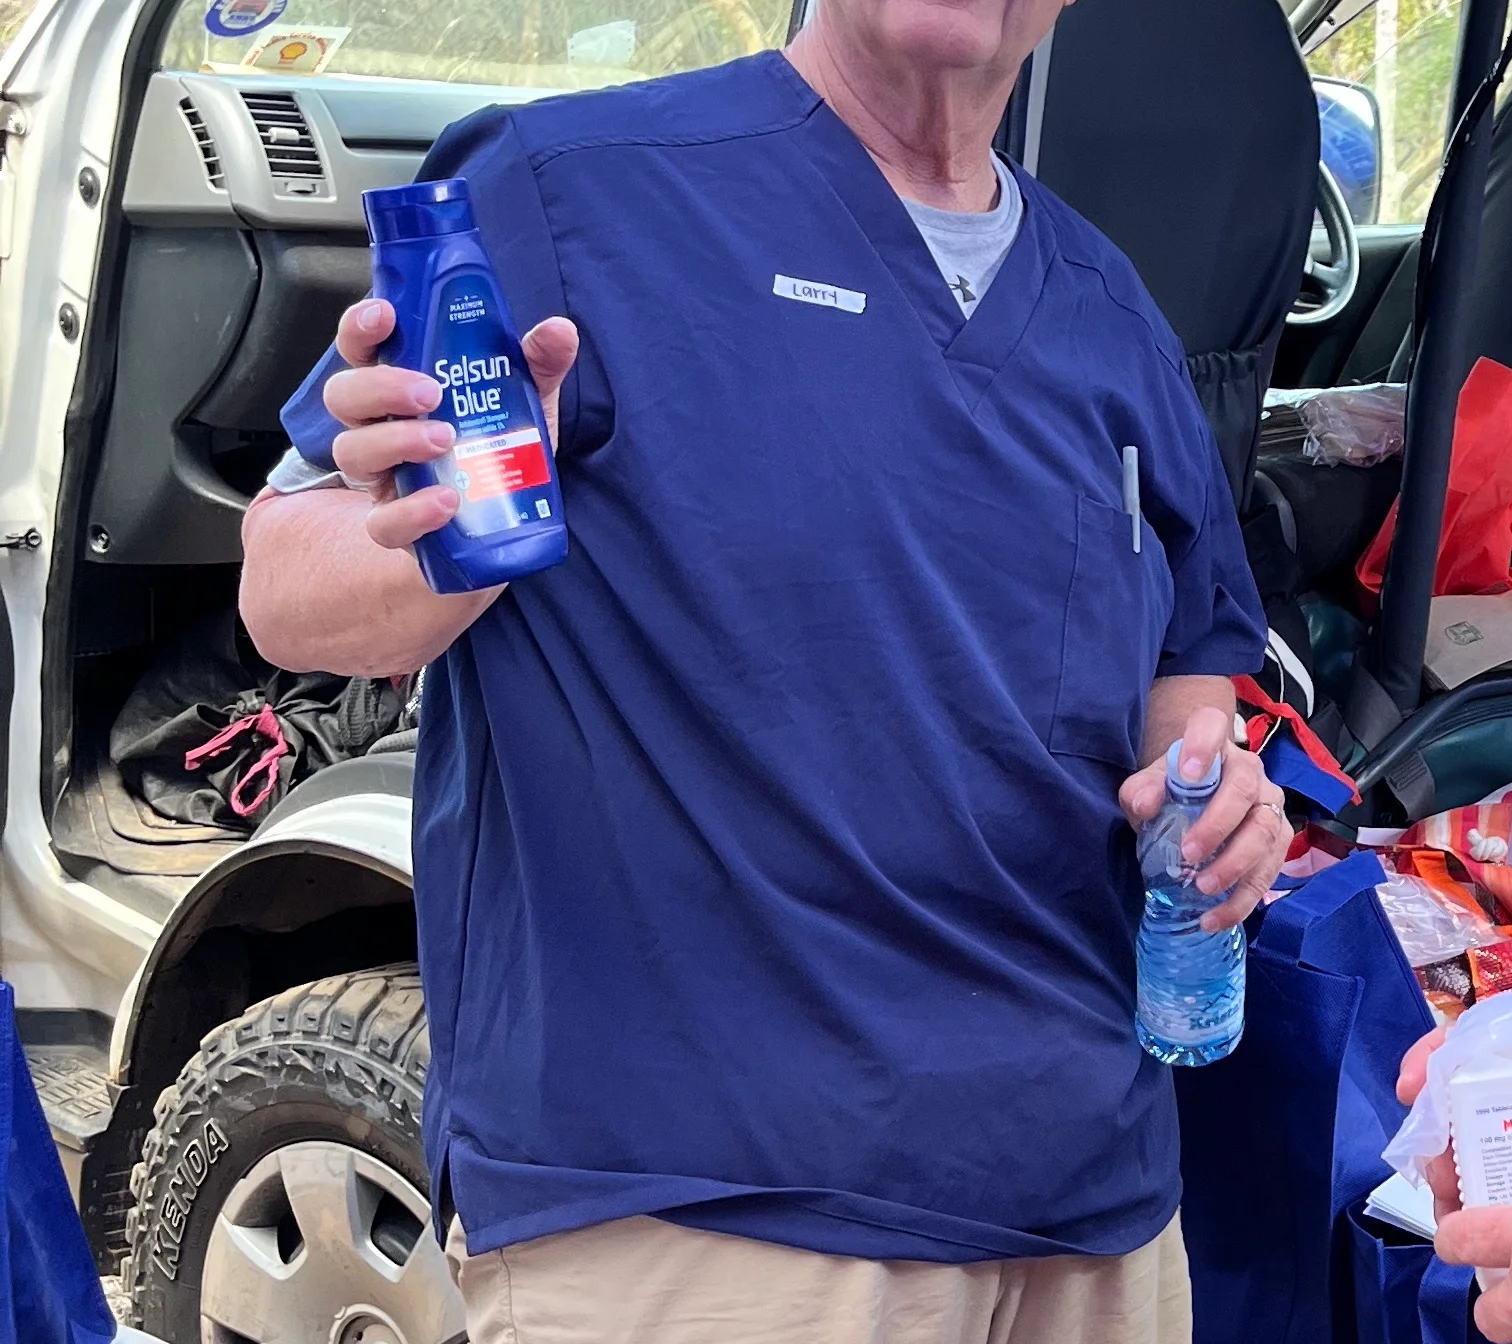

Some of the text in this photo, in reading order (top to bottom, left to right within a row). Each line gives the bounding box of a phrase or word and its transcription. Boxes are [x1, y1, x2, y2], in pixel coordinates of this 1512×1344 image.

[449, 299, 484, 312] MAXIMUM
[449, 308, 486, 322] STRENGTH
[434, 355, 511, 389] Selsun
[452, 385, 501, 417] blue
[152, 1117, 229, 1281] KENDA
